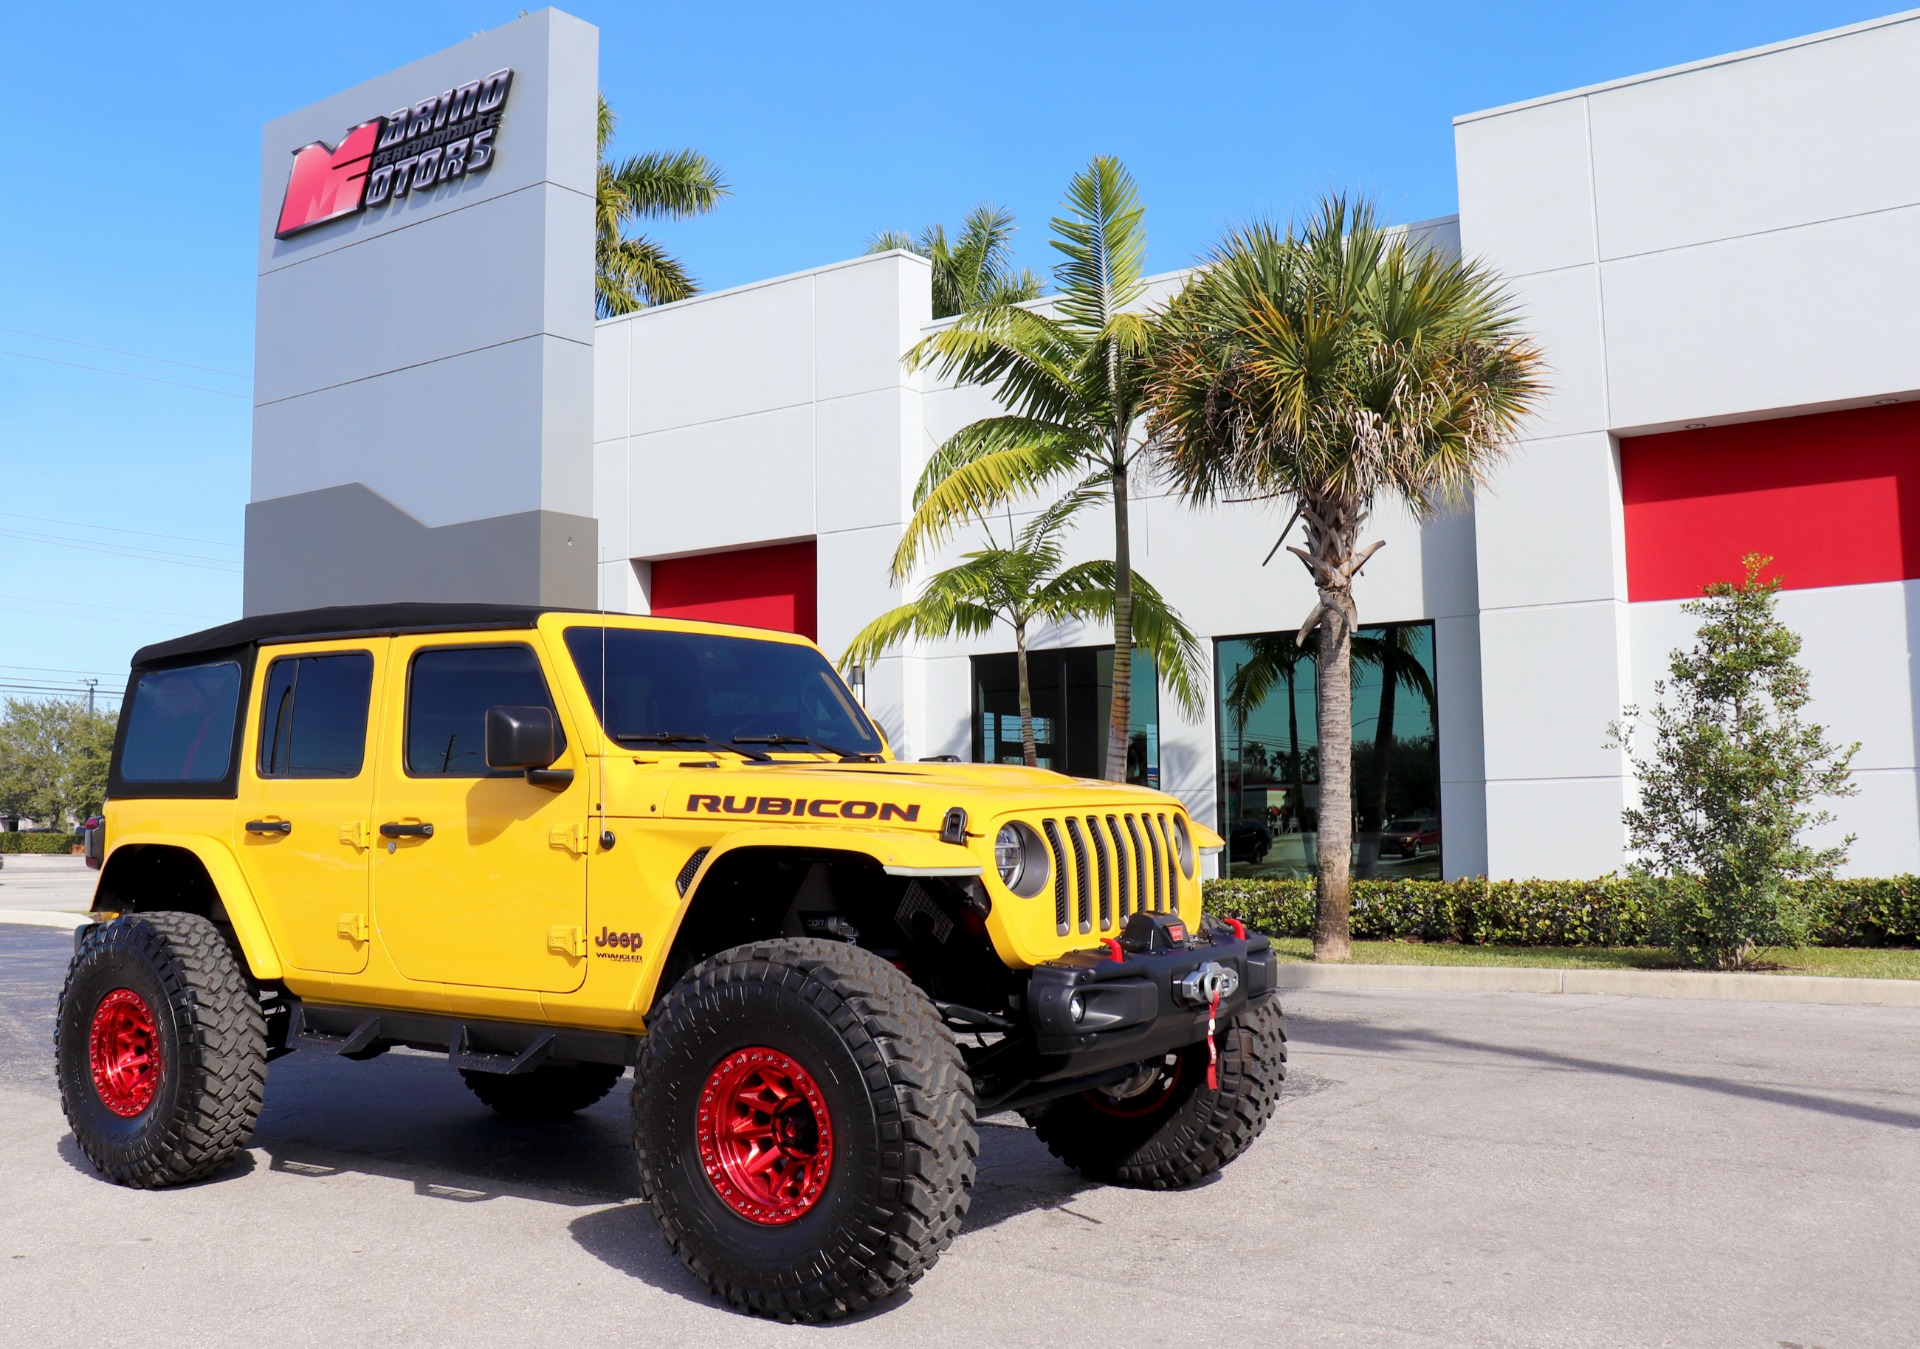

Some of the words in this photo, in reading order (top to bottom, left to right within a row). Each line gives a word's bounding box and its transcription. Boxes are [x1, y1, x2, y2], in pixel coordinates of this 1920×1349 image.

[372, 113, 500, 169] PERFORMANCE
[686, 794, 921, 822] RUBICON
[595, 926, 643, 952] Jeep
[596, 952, 643, 961] WRANGLER
